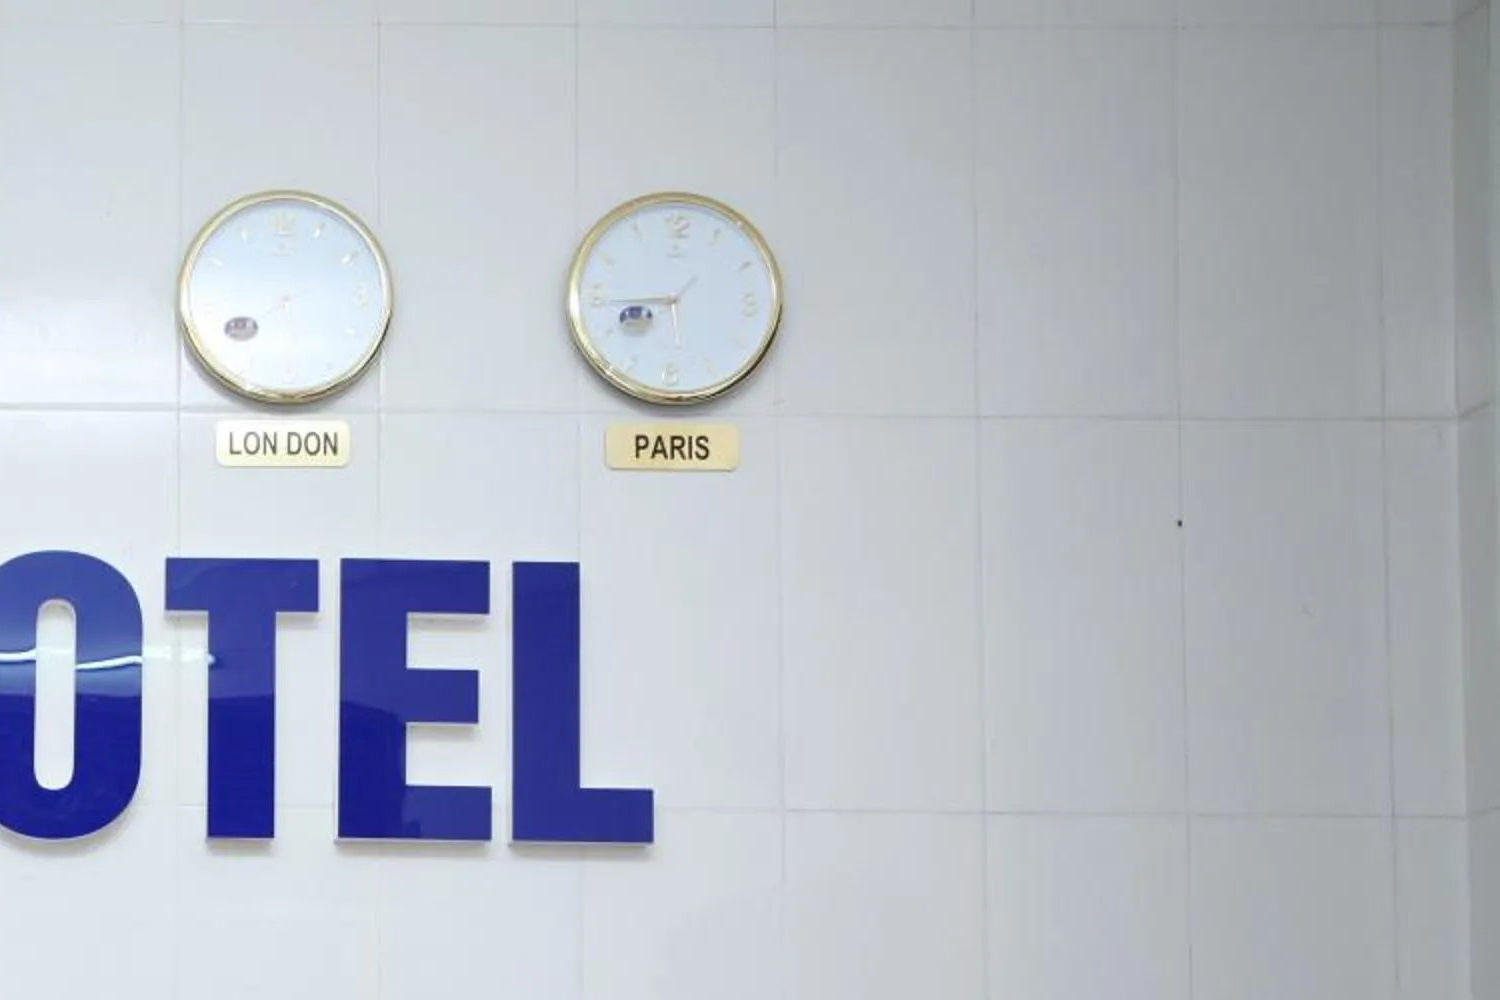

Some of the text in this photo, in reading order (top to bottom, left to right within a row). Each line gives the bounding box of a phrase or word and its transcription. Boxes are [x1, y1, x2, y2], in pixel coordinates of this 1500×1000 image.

[229, 431, 338, 457] LON DON
[634, 434, 711, 460] PARIS
